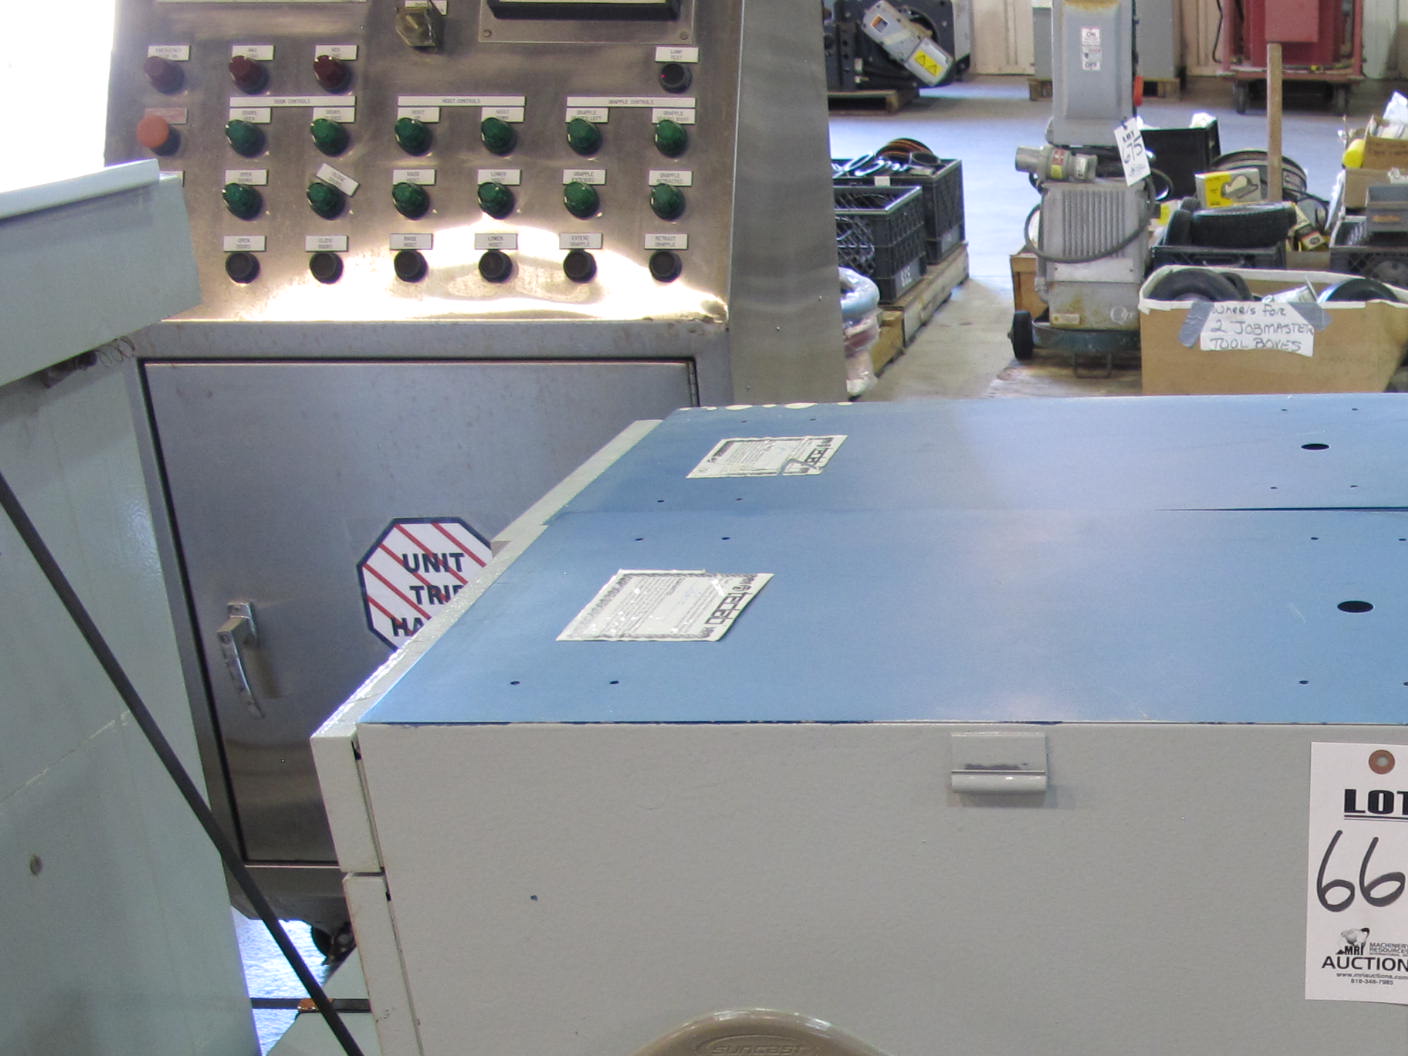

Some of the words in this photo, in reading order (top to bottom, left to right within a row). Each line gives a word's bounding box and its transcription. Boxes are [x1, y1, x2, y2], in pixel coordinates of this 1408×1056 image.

[1210, 320, 1227, 333] 2
[1230, 320, 1314, 336] JOBMASTER
[1210, 337, 1249, 350] TOOL
[1253, 338, 1302, 351] BOXES
[402, 553, 465, 573] UNIT
